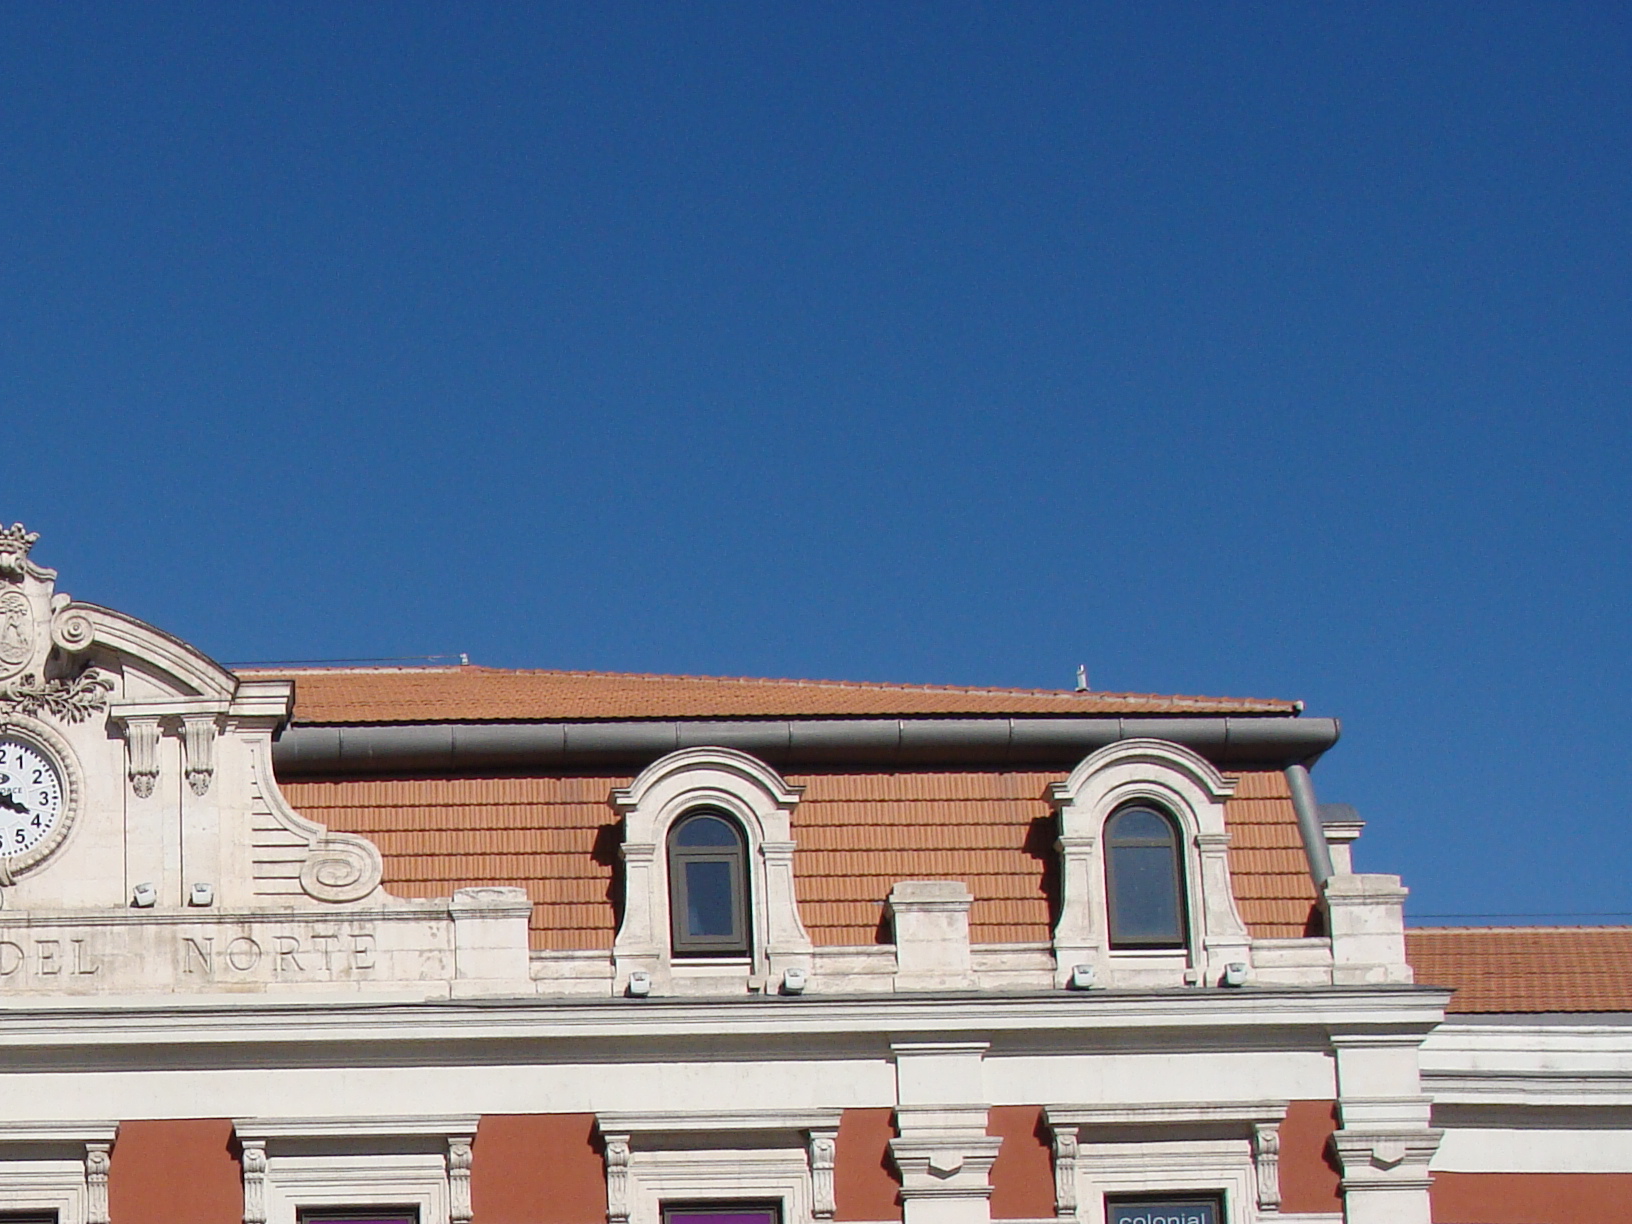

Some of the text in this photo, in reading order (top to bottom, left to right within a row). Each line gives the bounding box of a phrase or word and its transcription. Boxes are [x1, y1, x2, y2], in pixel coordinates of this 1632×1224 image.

[16, 755, 24, 769] 1
[32, 769, 43, 784] 2
[39, 791, 49, 806] 3
[30, 813, 41, 828] 4
[15, 829, 25, 844] 5
[182, 934, 377, 973] NORTE
